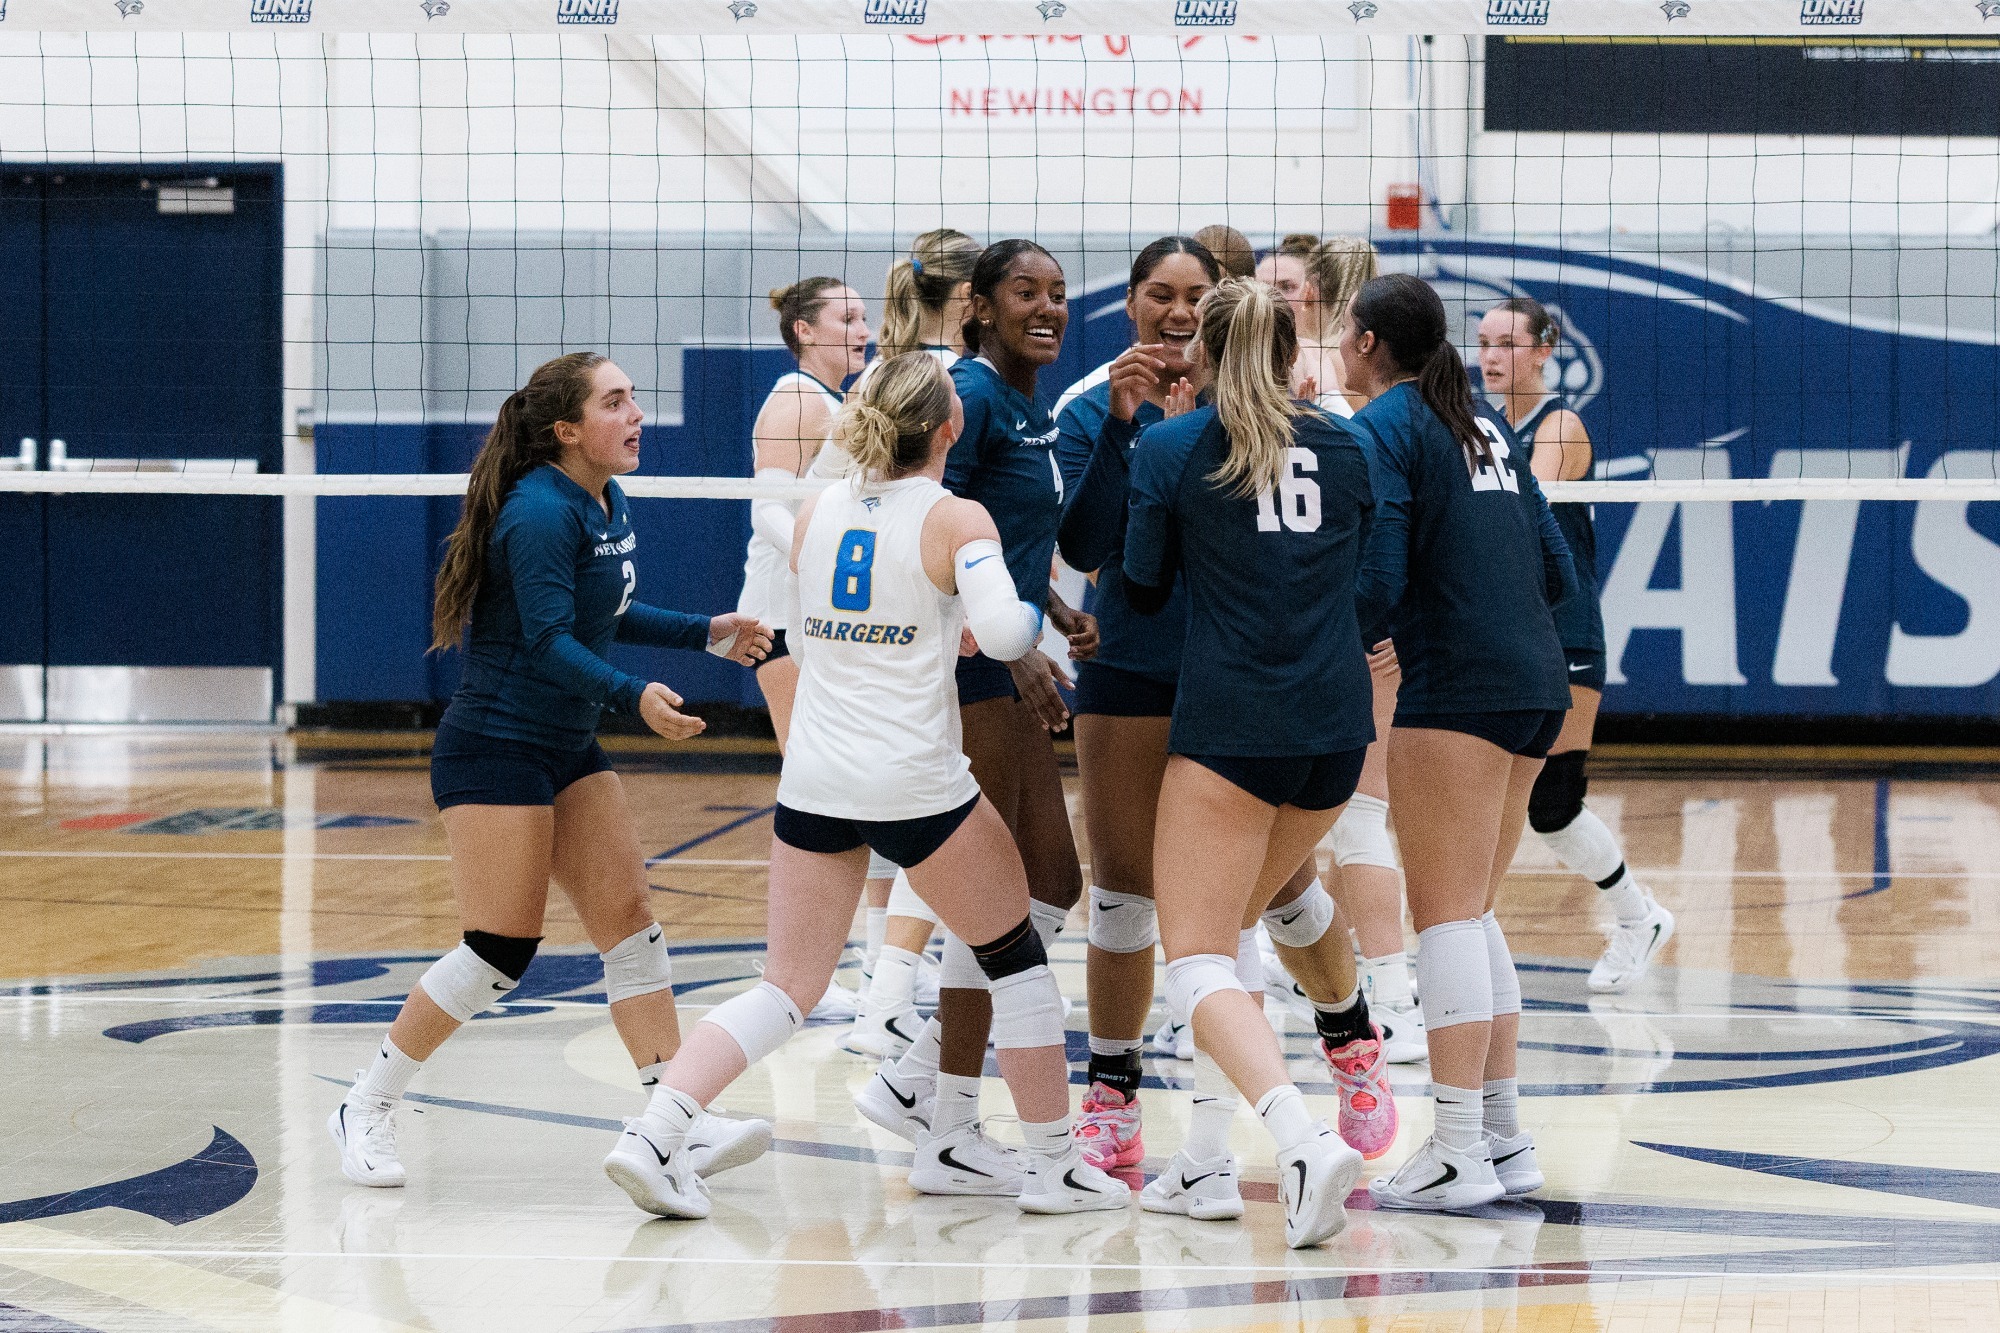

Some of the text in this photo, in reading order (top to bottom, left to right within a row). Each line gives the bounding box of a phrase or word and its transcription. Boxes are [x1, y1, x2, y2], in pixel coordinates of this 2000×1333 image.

[252, 0, 312, 14] UNH
[559, 0, 618, 15] UNH
[867, 0, 926, 15] UNH
[1177, 0, 1236, 16] UNH
[1489, 0, 1549, 15] UNH
[1803, 0, 1863, 15] UNH
[252, 14, 310, 23] WILDCATS
[558, 15, 616, 24] WILDCATS
[865, 15, 924, 24] WILDCATS
[1175, 16, 1235, 25] WILDCATS
[1487, 16, 1547, 25] WILDCATS
[1801, 16, 1861, 25] WILDCATS
[950, 87, 1202, 116] NEWINGTON
[1255, 447, 1322, 533] 16
[1595, 427, 2000, 688] ATS
[829, 526, 878, 614] 8
[614, 559, 636, 617] 2
[804, 616, 918, 646] CHARGERS
